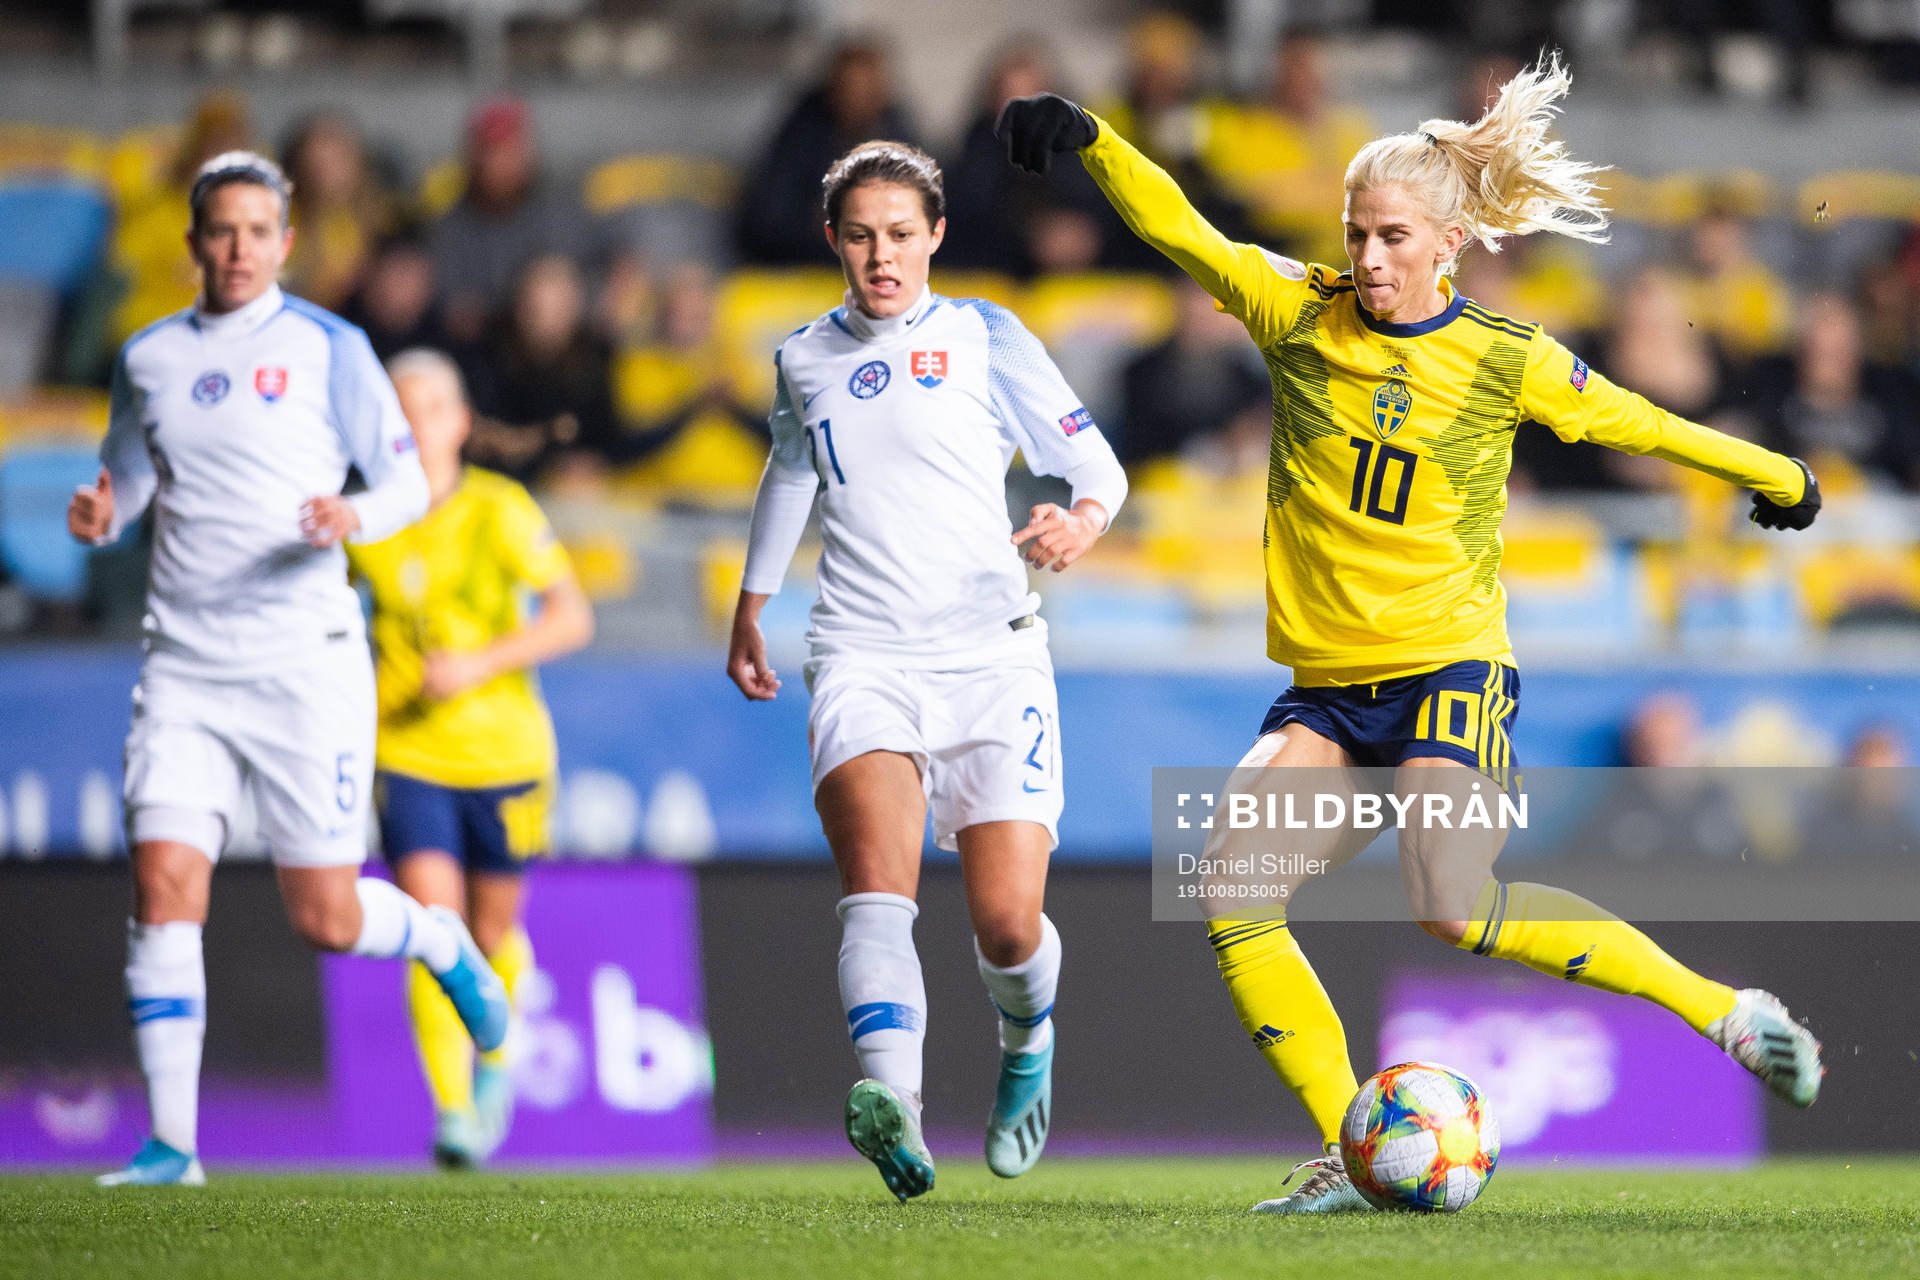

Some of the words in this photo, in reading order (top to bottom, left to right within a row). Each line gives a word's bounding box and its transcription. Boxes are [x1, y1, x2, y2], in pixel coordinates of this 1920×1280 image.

[1349, 436, 1418, 526] 10
[1022, 706, 1053, 779] 21
[1415, 690, 1481, 752] 10
[335, 752, 357, 815] 5
